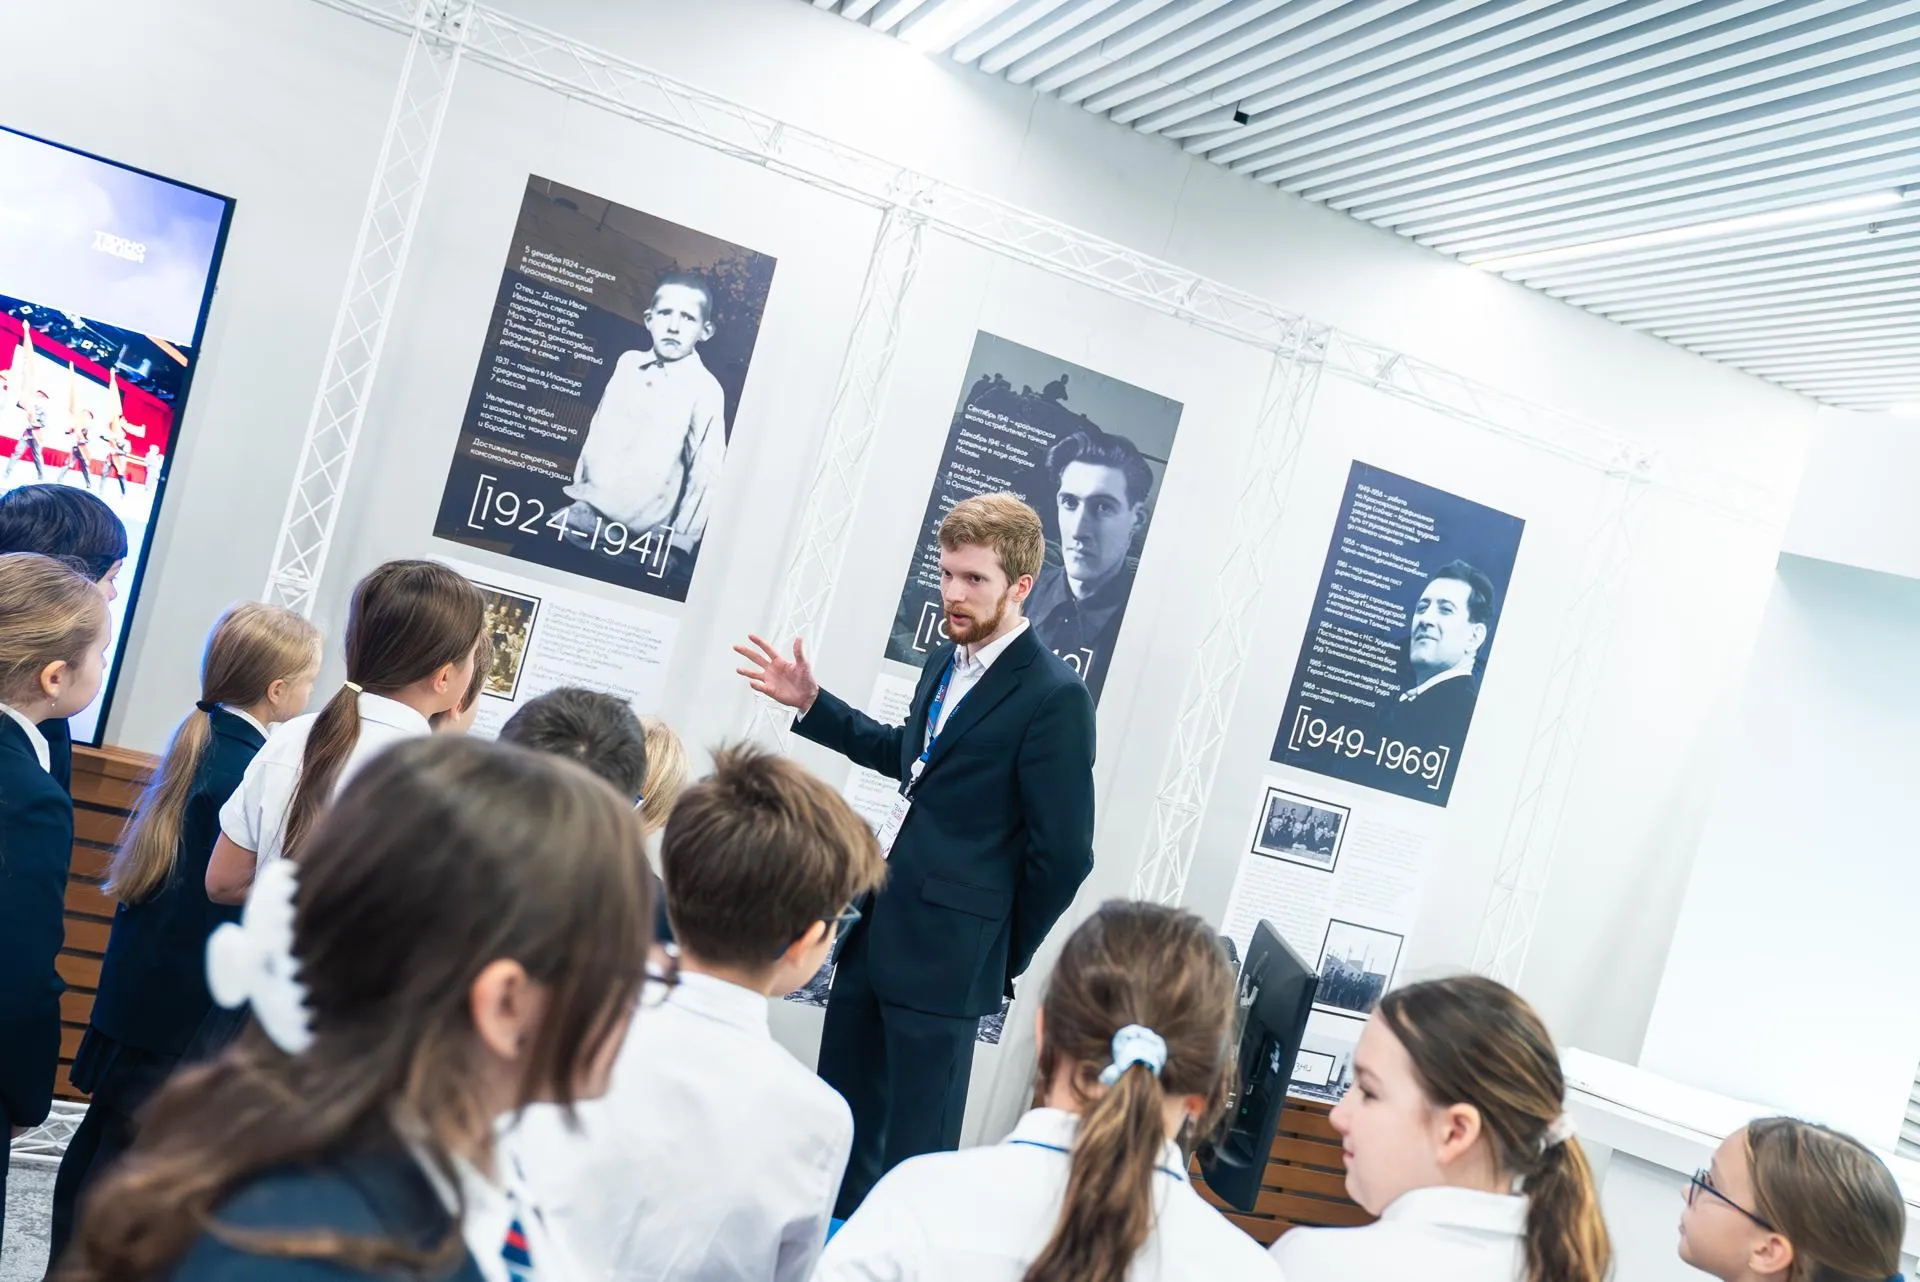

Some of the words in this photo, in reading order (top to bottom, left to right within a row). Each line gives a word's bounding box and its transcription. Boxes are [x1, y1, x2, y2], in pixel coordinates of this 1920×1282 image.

[531, 250, 562, 263] декабря
[562, 258, 578, 268] 1924
[586, 268, 616, 281] родился
[520, 264, 574, 287] Красноярского
[559, 267, 593, 284] Иланский
[515, 283, 534, 295] Отец
[542, 291, 568, 305] Долгих
[569, 300, 587, 311] Иван
[510, 302, 556, 320] паровозного
[550, 305, 579, 318] слесарь
[507, 309, 526, 321] Мать
[534, 319, 561, 332] Долгих
[561, 327, 583, 339] Елена
[503, 328, 539, 345] Владимир
[540, 340, 566, 353] Долгих
[574, 352, 603, 365] девятый
[493, 366, 526, 380] среднюю
[551, 384, 580, 396] окончил
[496, 356, 509, 365] 1931
[546, 371, 582, 387] Иланскую
[527, 406, 554, 418] футбол
[528, 426, 567, 441] мандолине
[551, 423, 567, 432] игра
[470, 449, 526, 468] комсомольской
[520, 453, 558, 468] секретарь
